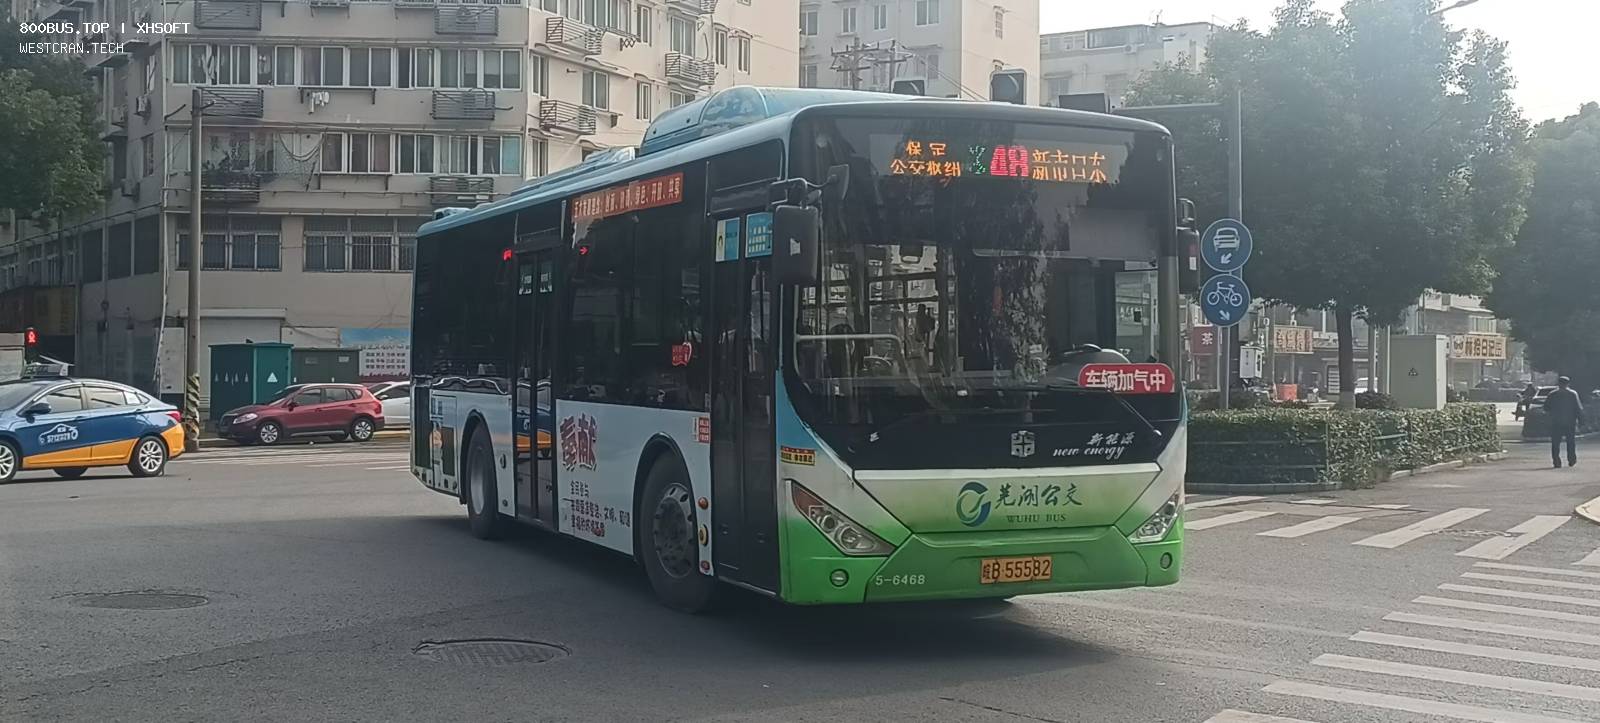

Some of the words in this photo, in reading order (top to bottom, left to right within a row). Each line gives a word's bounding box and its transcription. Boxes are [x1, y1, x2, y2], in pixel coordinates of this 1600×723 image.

[1085, 369, 1166, 392] 车辆加气中
[1086, 432, 1136, 445] 新能源
[1053, 448, 1080, 457] new
[1083, 446, 1126, 460] energy
[994, 482, 1083, 510] 芜湖公交
[1007, 514, 1041, 523] WUHU
[1046, 513, 1067, 523] BUS
[875, 574, 926, 585] 5-6468
